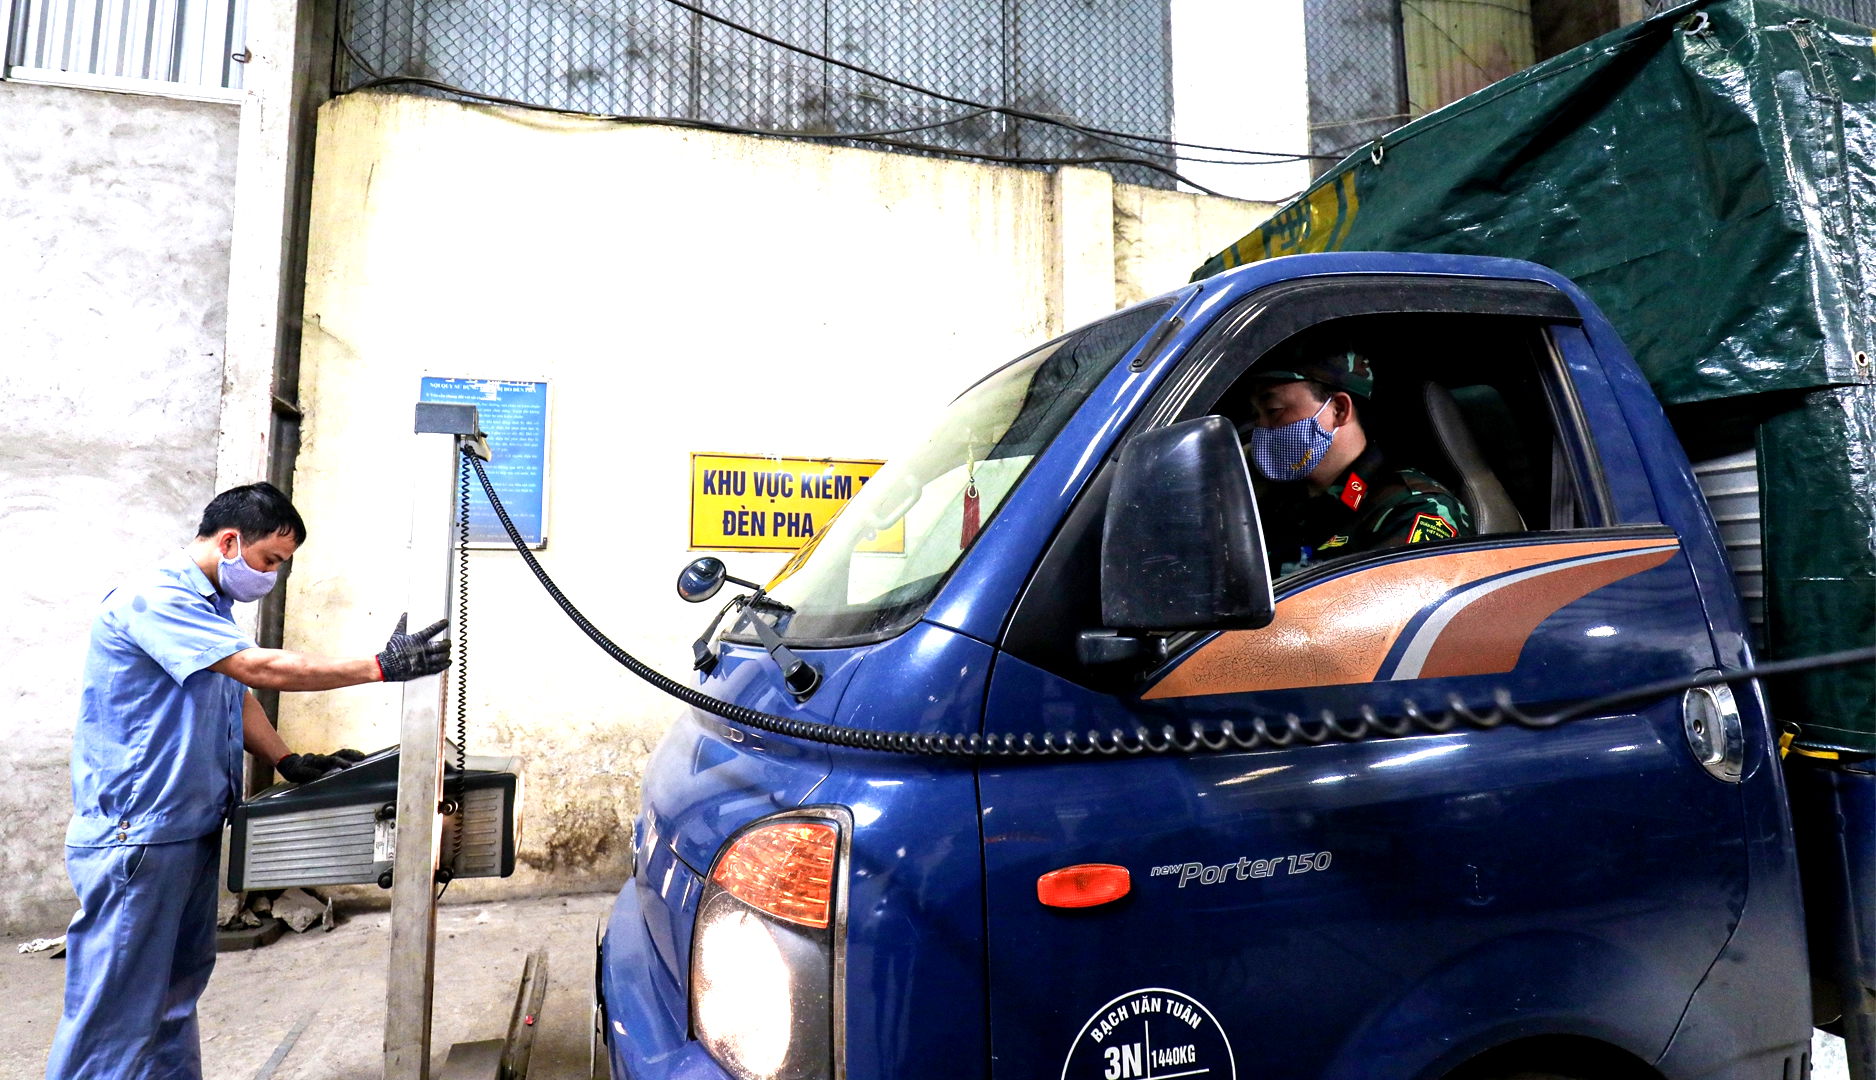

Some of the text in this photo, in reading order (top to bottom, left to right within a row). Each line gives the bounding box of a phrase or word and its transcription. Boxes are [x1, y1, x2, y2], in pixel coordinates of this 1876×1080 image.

[703, 464, 852, 503] KHU VỰC KIỂM
[723, 505, 814, 537] ĐÈN PHA
[1151, 851, 1332, 888] new Porter 150
[1090, 995, 1203, 1043] BẠCH VĂN TUÂN
[1104, 1042, 1196, 1080] 3N 1440KG
